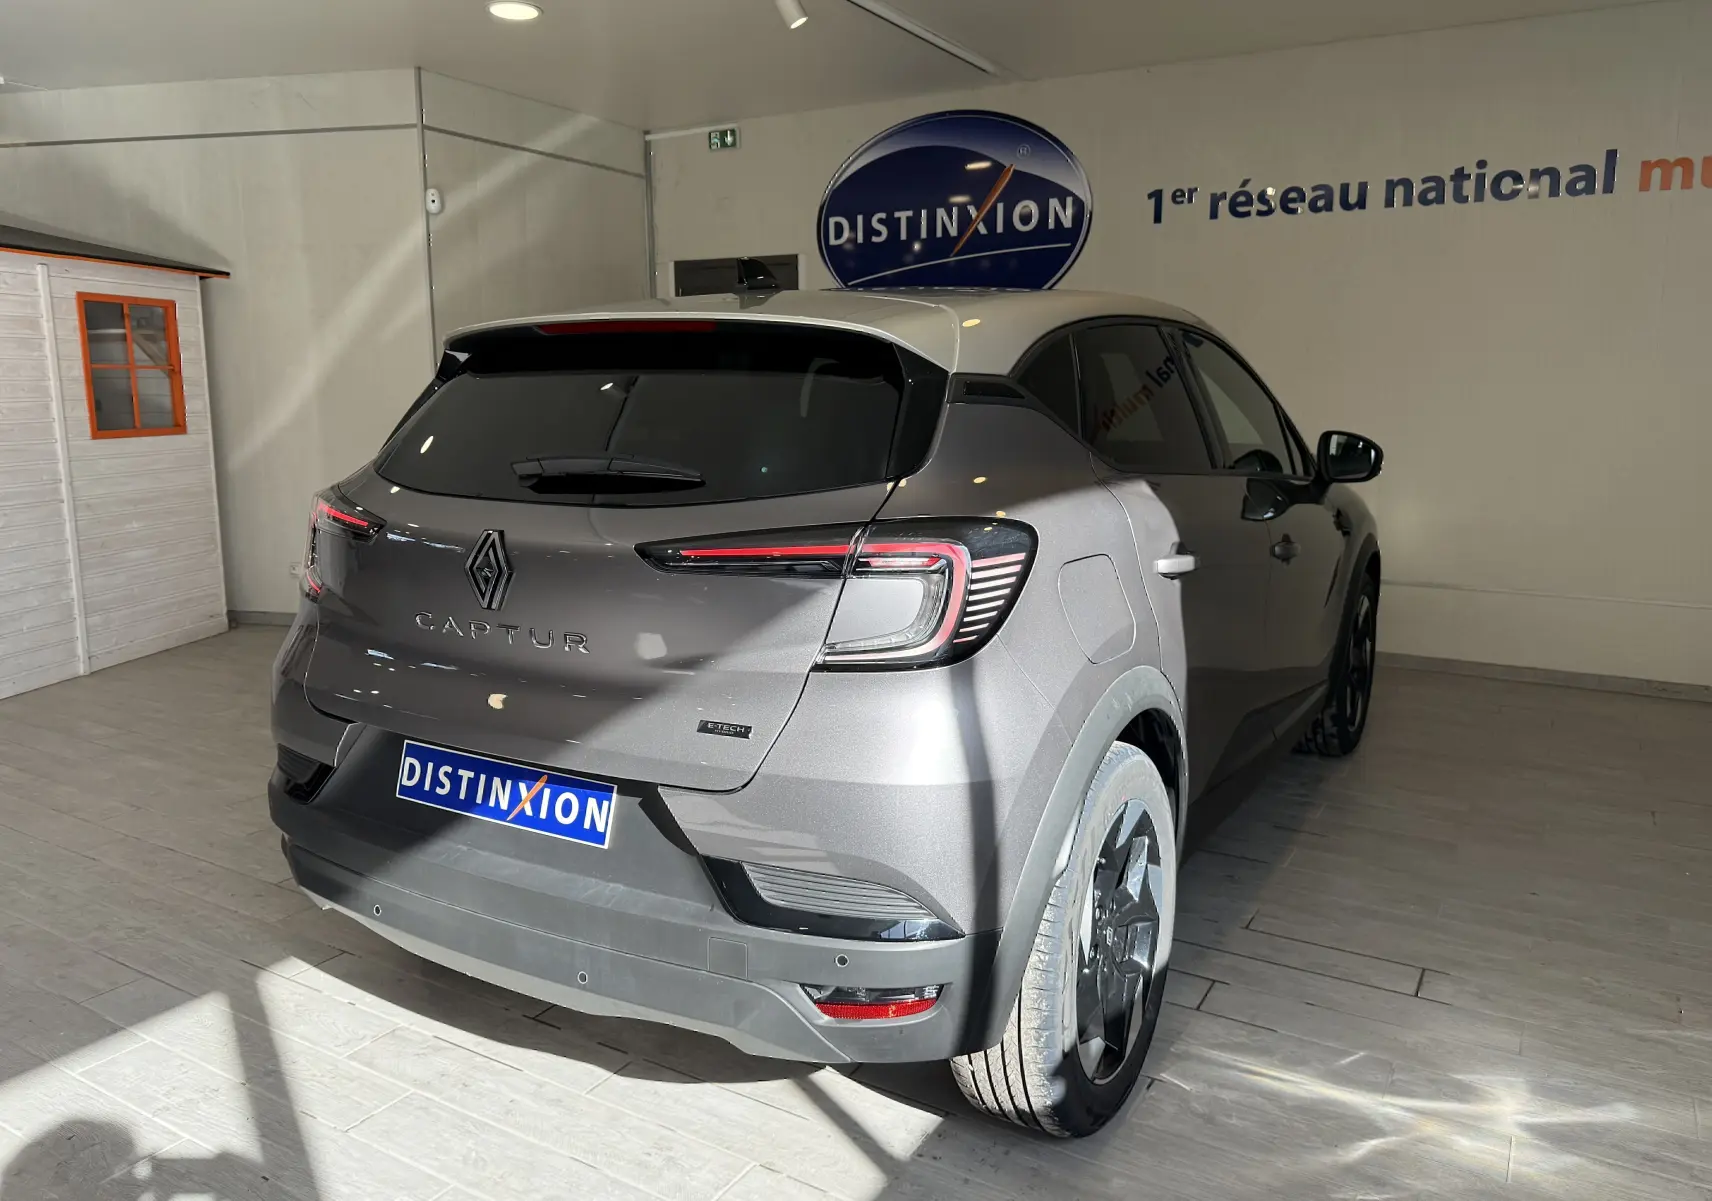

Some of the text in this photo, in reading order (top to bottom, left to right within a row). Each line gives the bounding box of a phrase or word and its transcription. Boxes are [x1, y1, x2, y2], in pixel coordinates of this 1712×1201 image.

[1146, 185, 1199, 224] 1er
[1209, 179, 1370, 220] réseau
[1383, 148, 1619, 208] national
[828, 195, 1073, 249] DISTINXION
[414, 611, 590, 654] CAPTUR
[401, 757, 610, 833] DISTINXION
